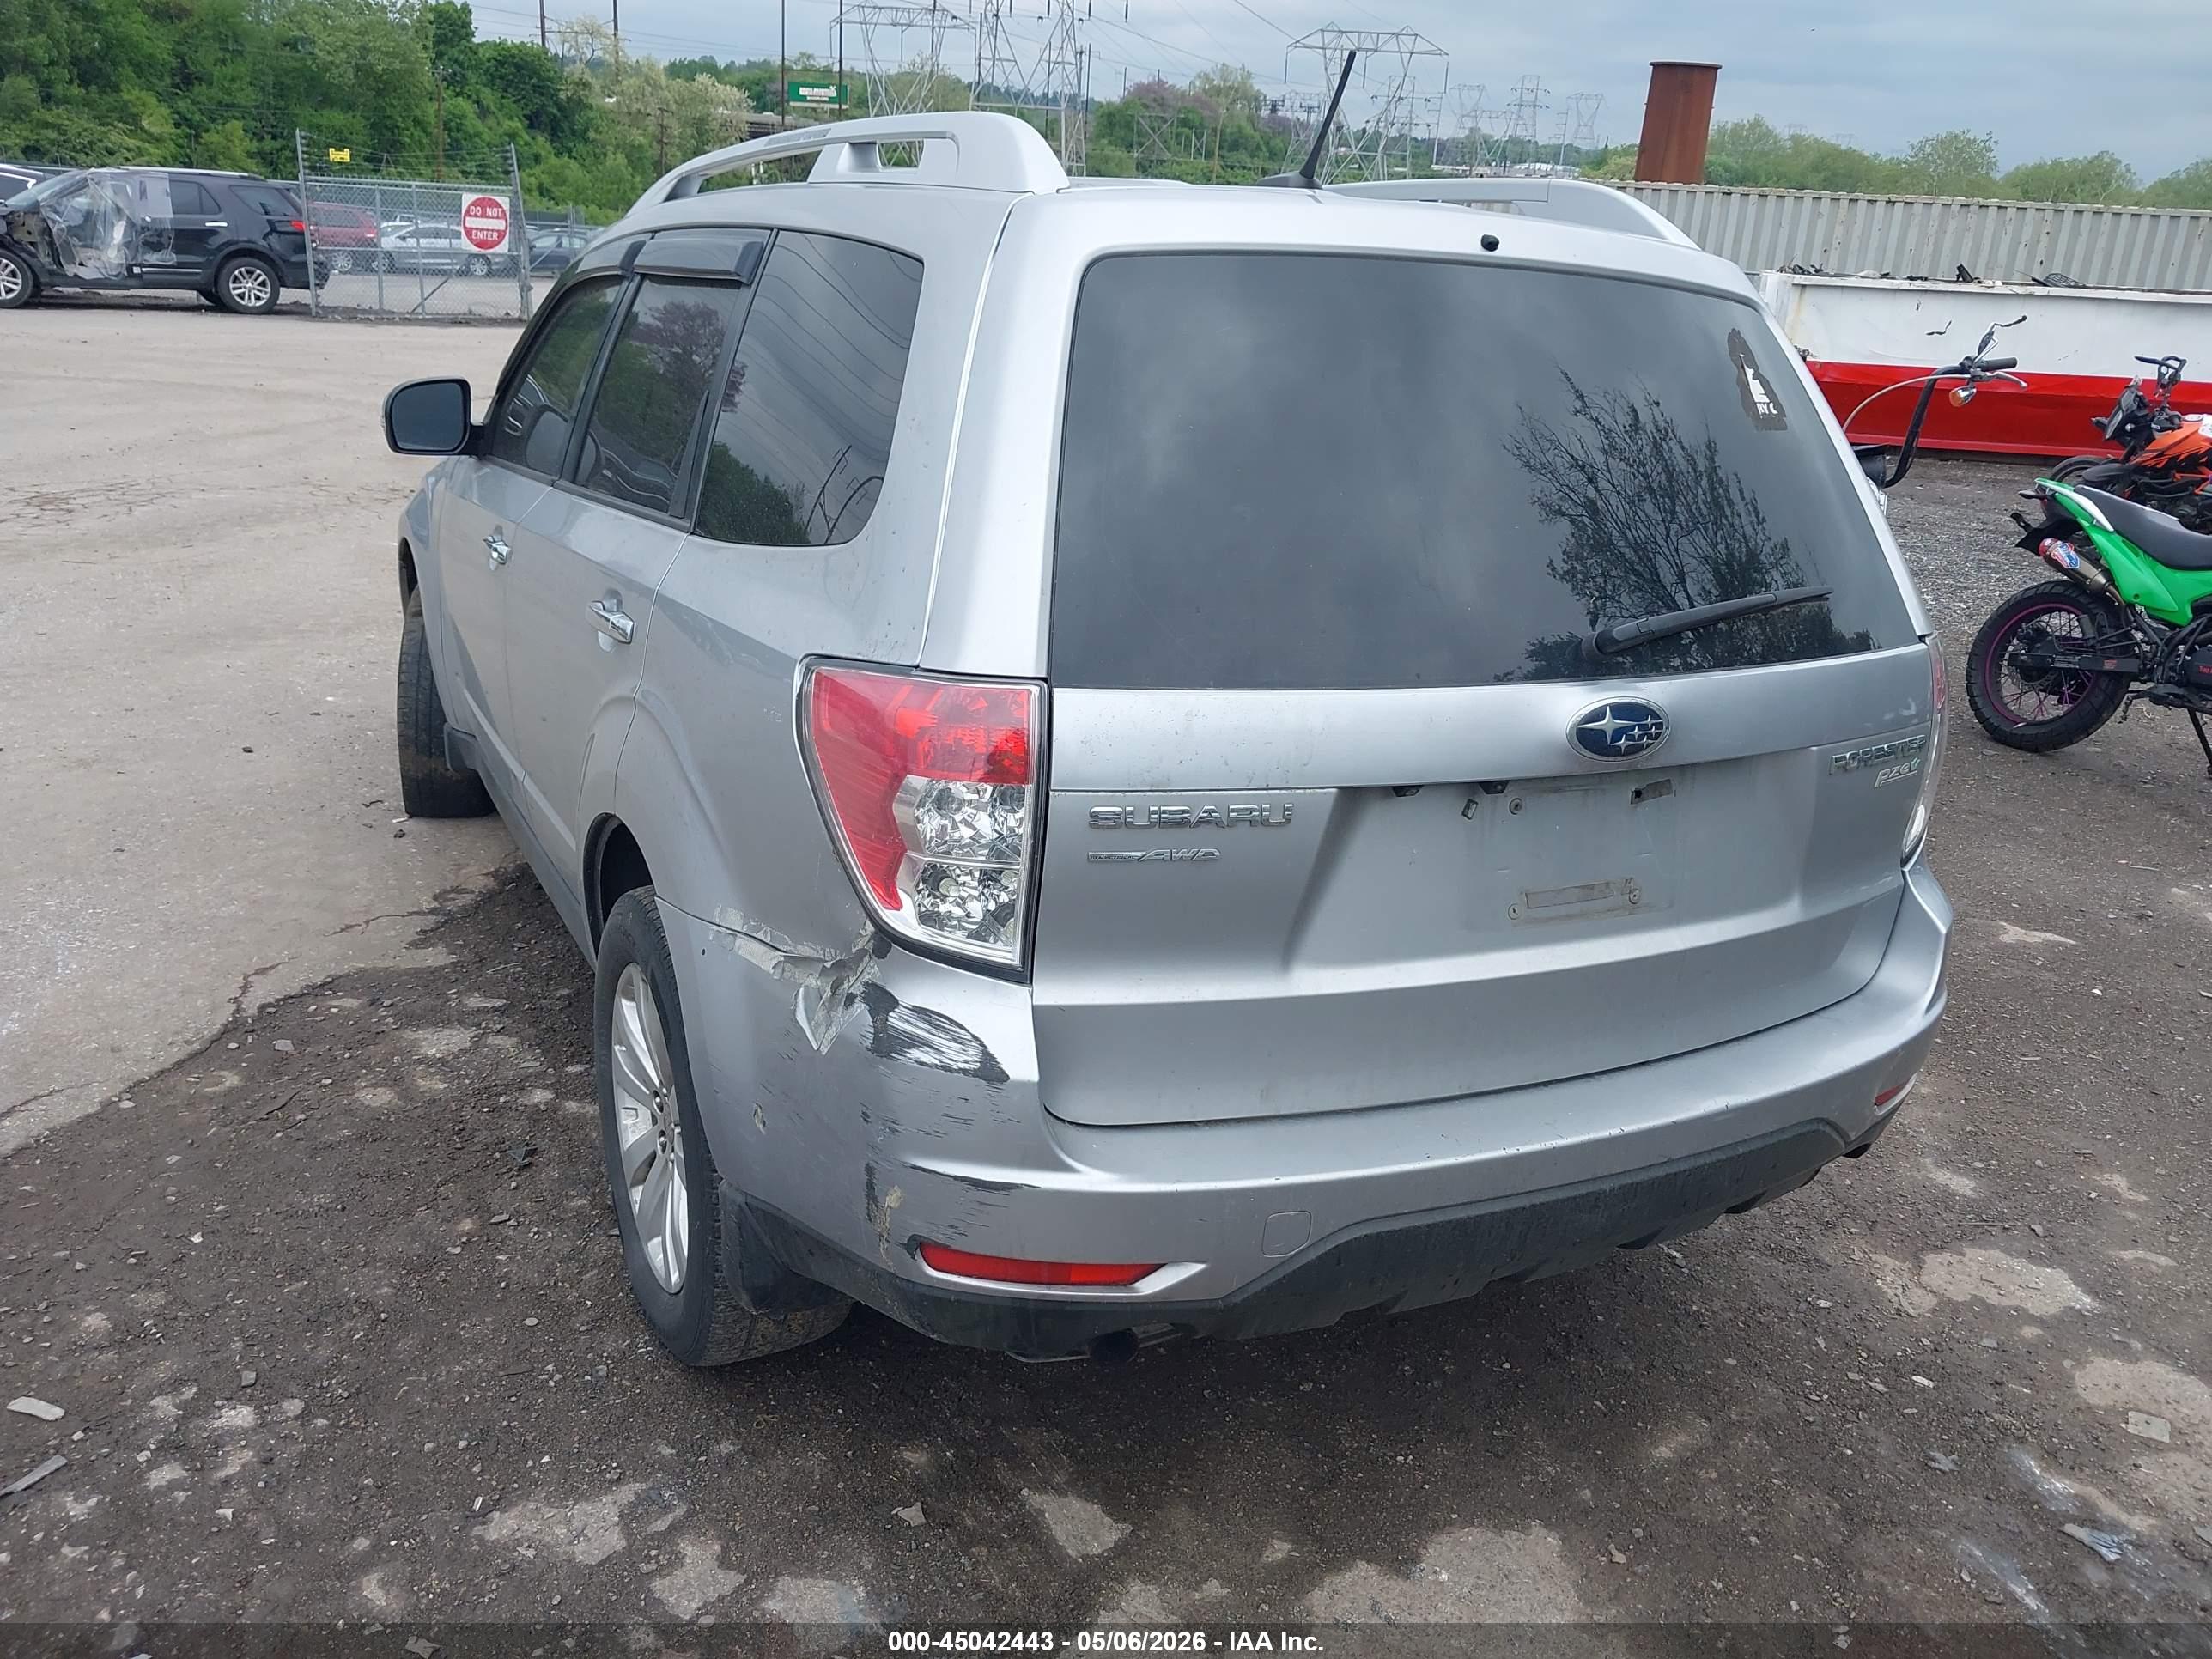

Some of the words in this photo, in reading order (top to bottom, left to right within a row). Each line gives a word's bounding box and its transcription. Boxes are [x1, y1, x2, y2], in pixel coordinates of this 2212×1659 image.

[470, 206, 482, 216] DO
[486, 207, 502, 217] NOT
[472, 230, 498, 241] ENTER
[1830, 734, 1926, 775] FORESTER
[1088, 803, 1294, 830] SUBARU
[1139, 848, 1221, 862] AWD
